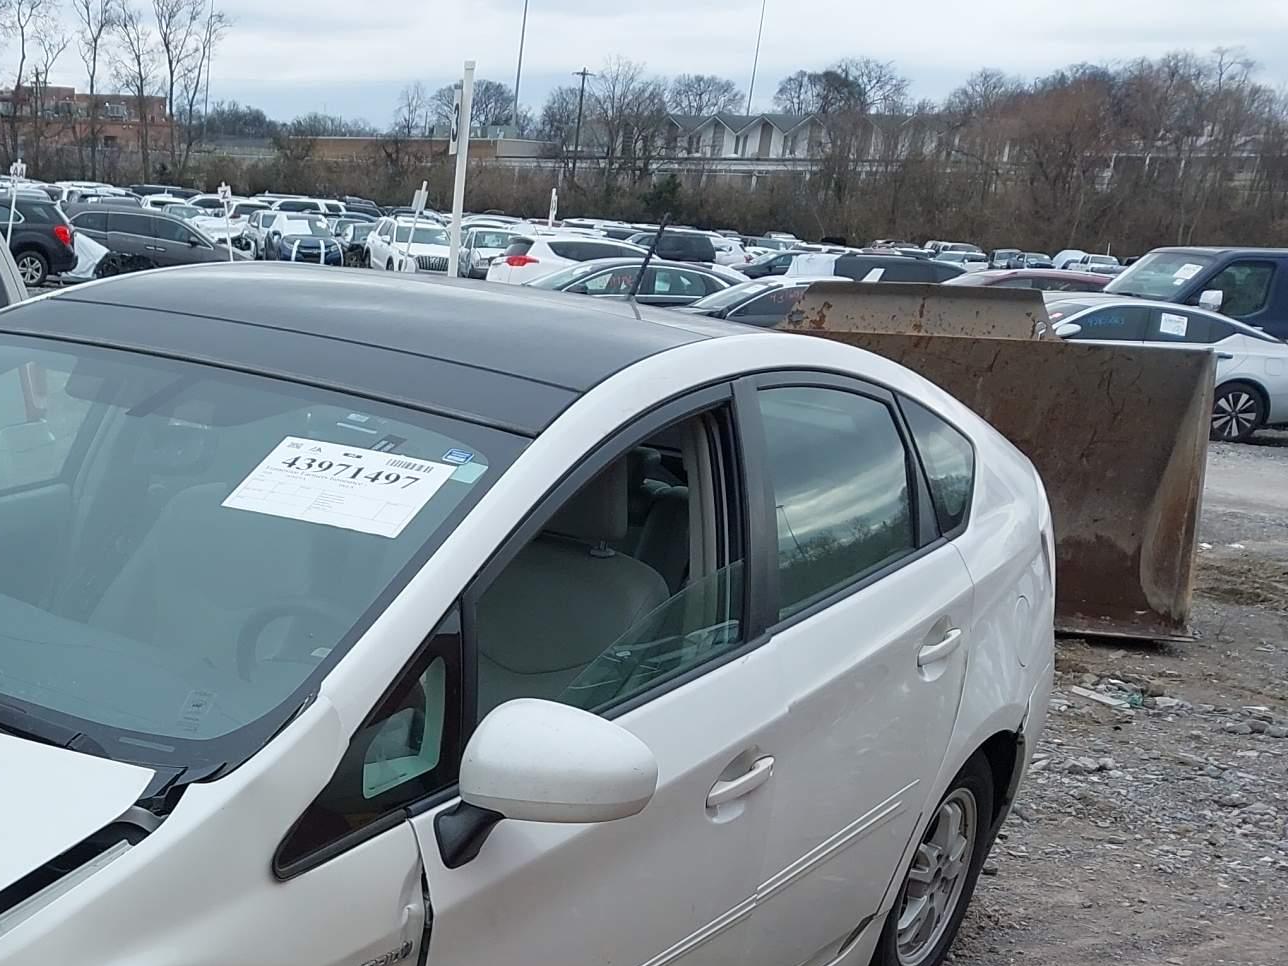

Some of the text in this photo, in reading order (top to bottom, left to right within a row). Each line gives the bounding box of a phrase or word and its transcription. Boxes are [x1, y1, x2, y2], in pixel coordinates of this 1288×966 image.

[451, 103, 460, 143] 3
[12, 166, 24, 179] AA
[220, 189, 229, 200] Z
[281, 456, 420, 489] 43971497
